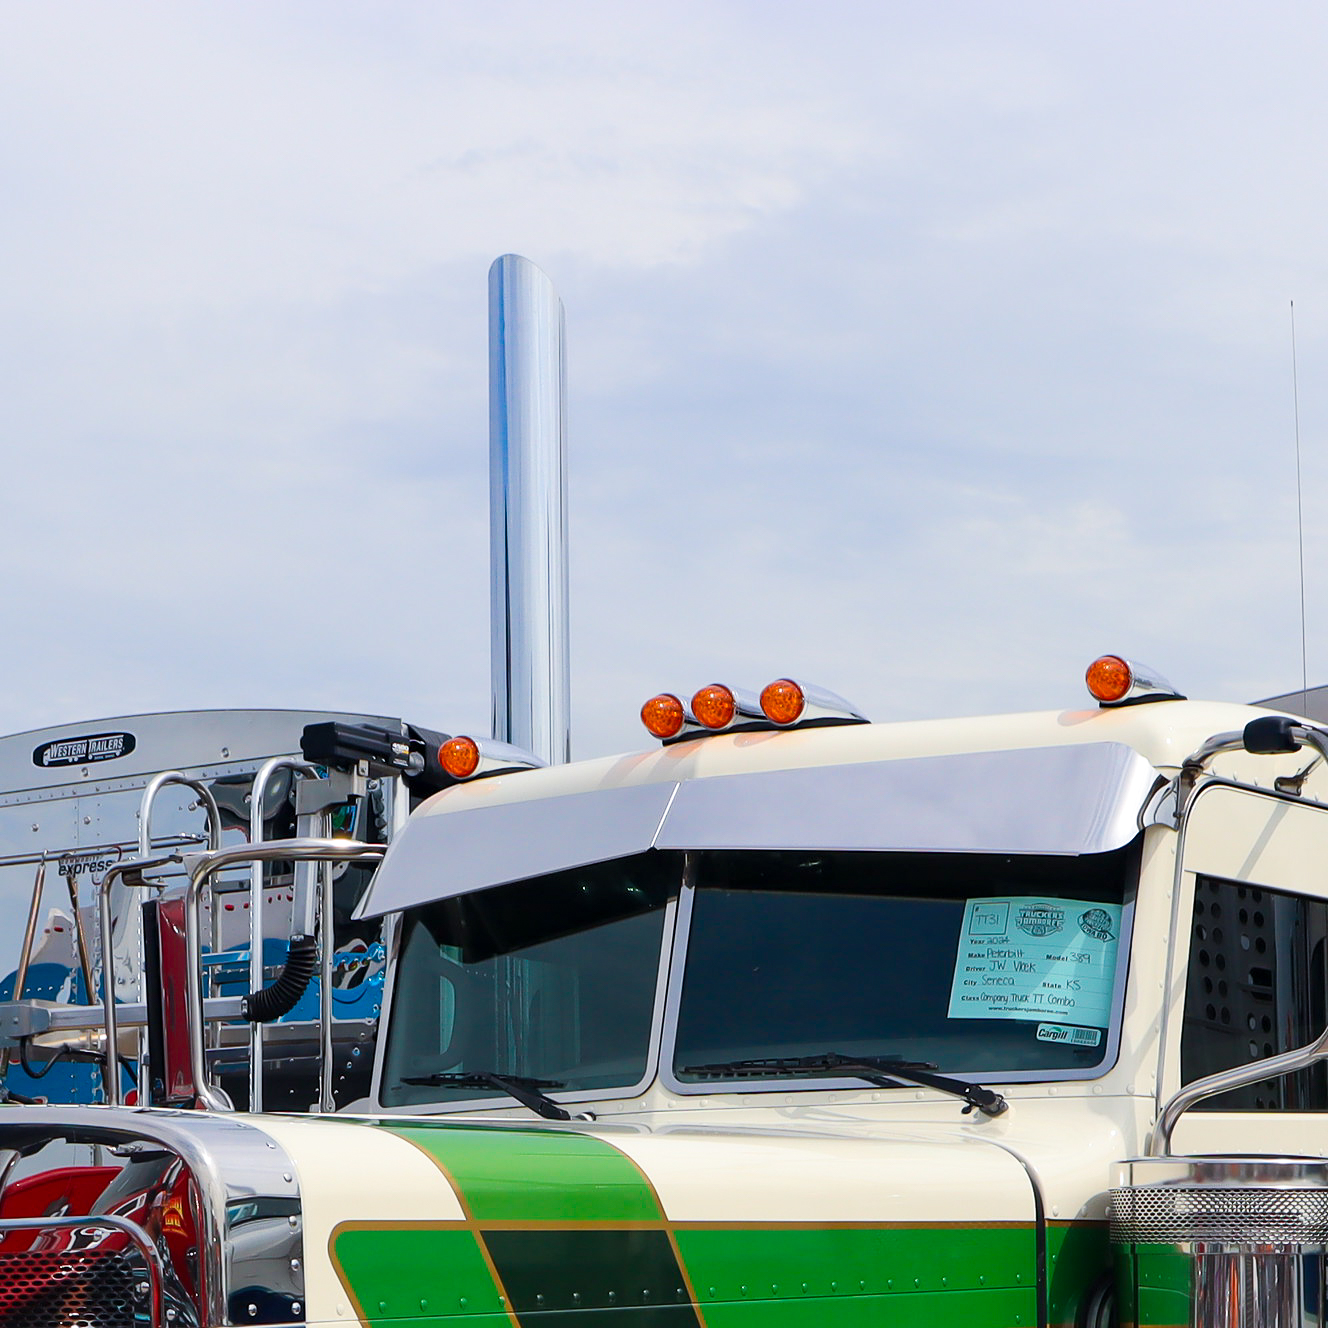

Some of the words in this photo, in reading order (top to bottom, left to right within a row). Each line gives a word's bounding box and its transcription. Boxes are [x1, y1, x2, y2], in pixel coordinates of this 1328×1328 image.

[50, 742, 88, 758] WESTERN
[88, 738, 125, 756] TRAILERS
[58, 860, 113, 878] express
[1019, 910, 1064, 920] TRUCKERS
[1017, 917, 1063, 927] JAMBOREE
[987, 948, 1025, 959] Peterbilt
[1046, 954, 1069, 962] Model
[1071, 952, 1091, 964] 389
[989, 960, 1007, 972] JW
[982, 974, 1015, 986] Seneca
[1066, 979, 1082, 991] KS
[1048, 996, 1075, 1007] Combo
[1038, 1028, 1068, 1040] Cargill
